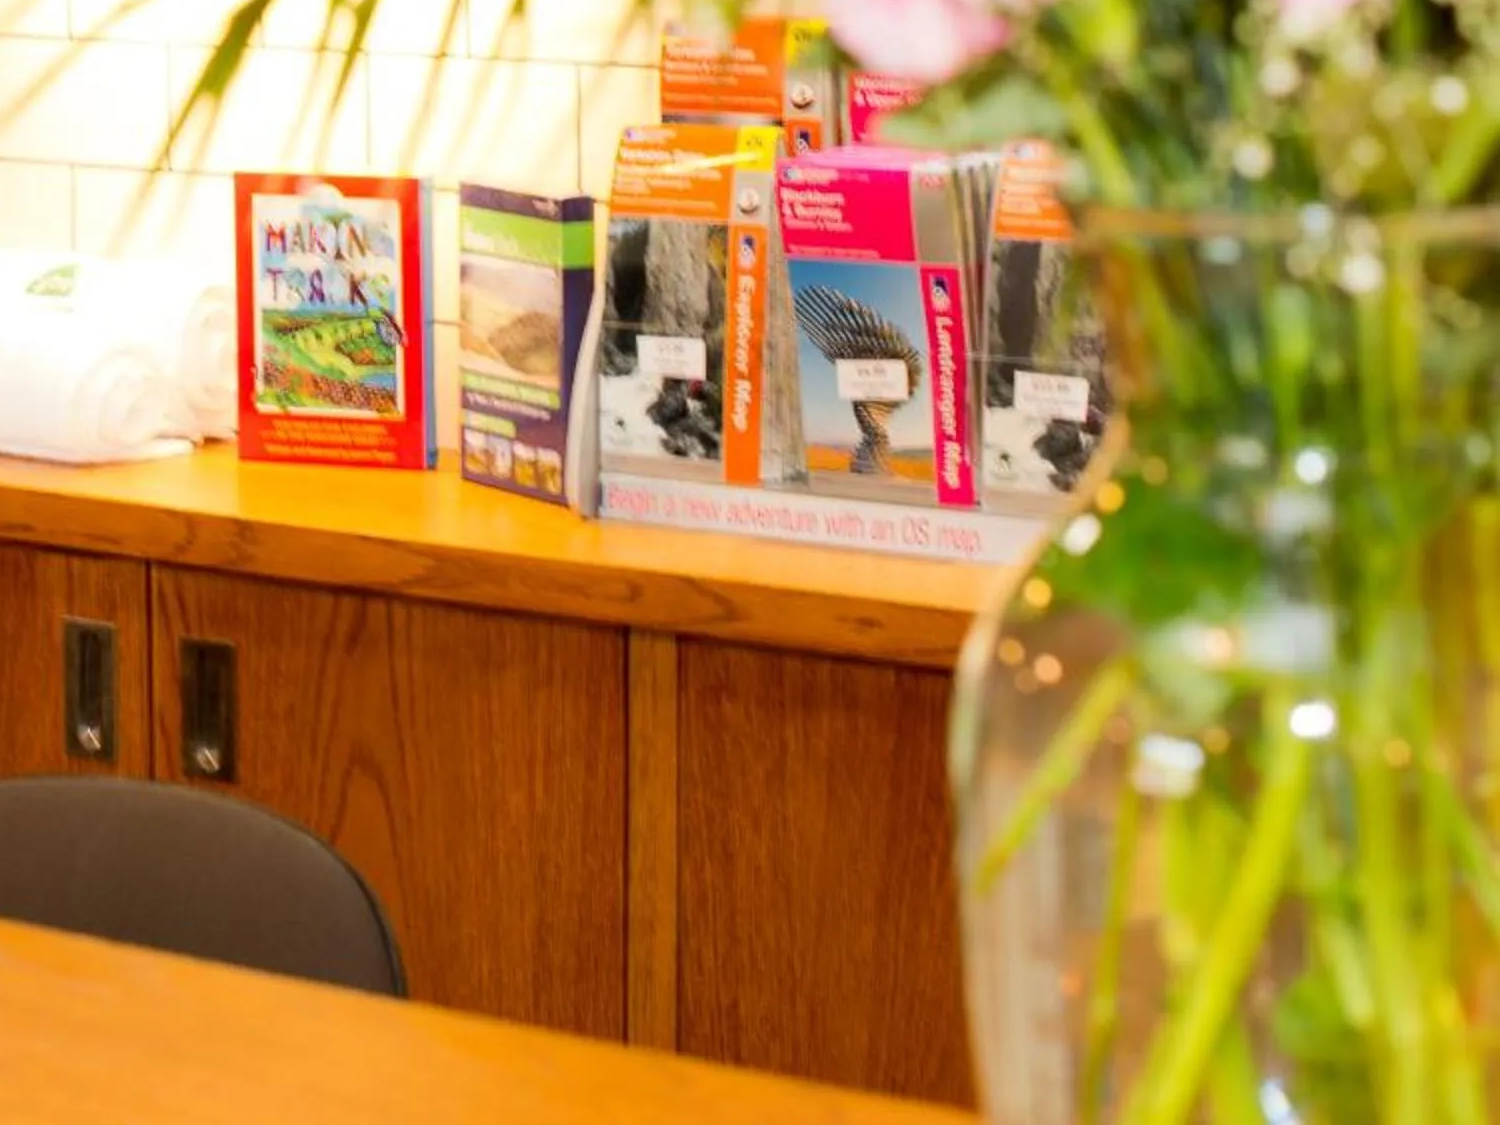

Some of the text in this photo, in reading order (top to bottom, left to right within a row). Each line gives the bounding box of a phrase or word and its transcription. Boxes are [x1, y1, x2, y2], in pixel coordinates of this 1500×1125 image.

[733, 274, 756, 375] Explorer
[731, 377, 753, 434] Map
[934, 315, 957, 439] Landranger
[942, 440, 962, 489] Map
[608, 483, 656, 516] Begin
[683, 497, 722, 520] new
[726, 499, 820, 534] adventure
[825, 508, 866, 539] with
[869, 515, 895, 542] an
[900, 515, 930, 545] OS
